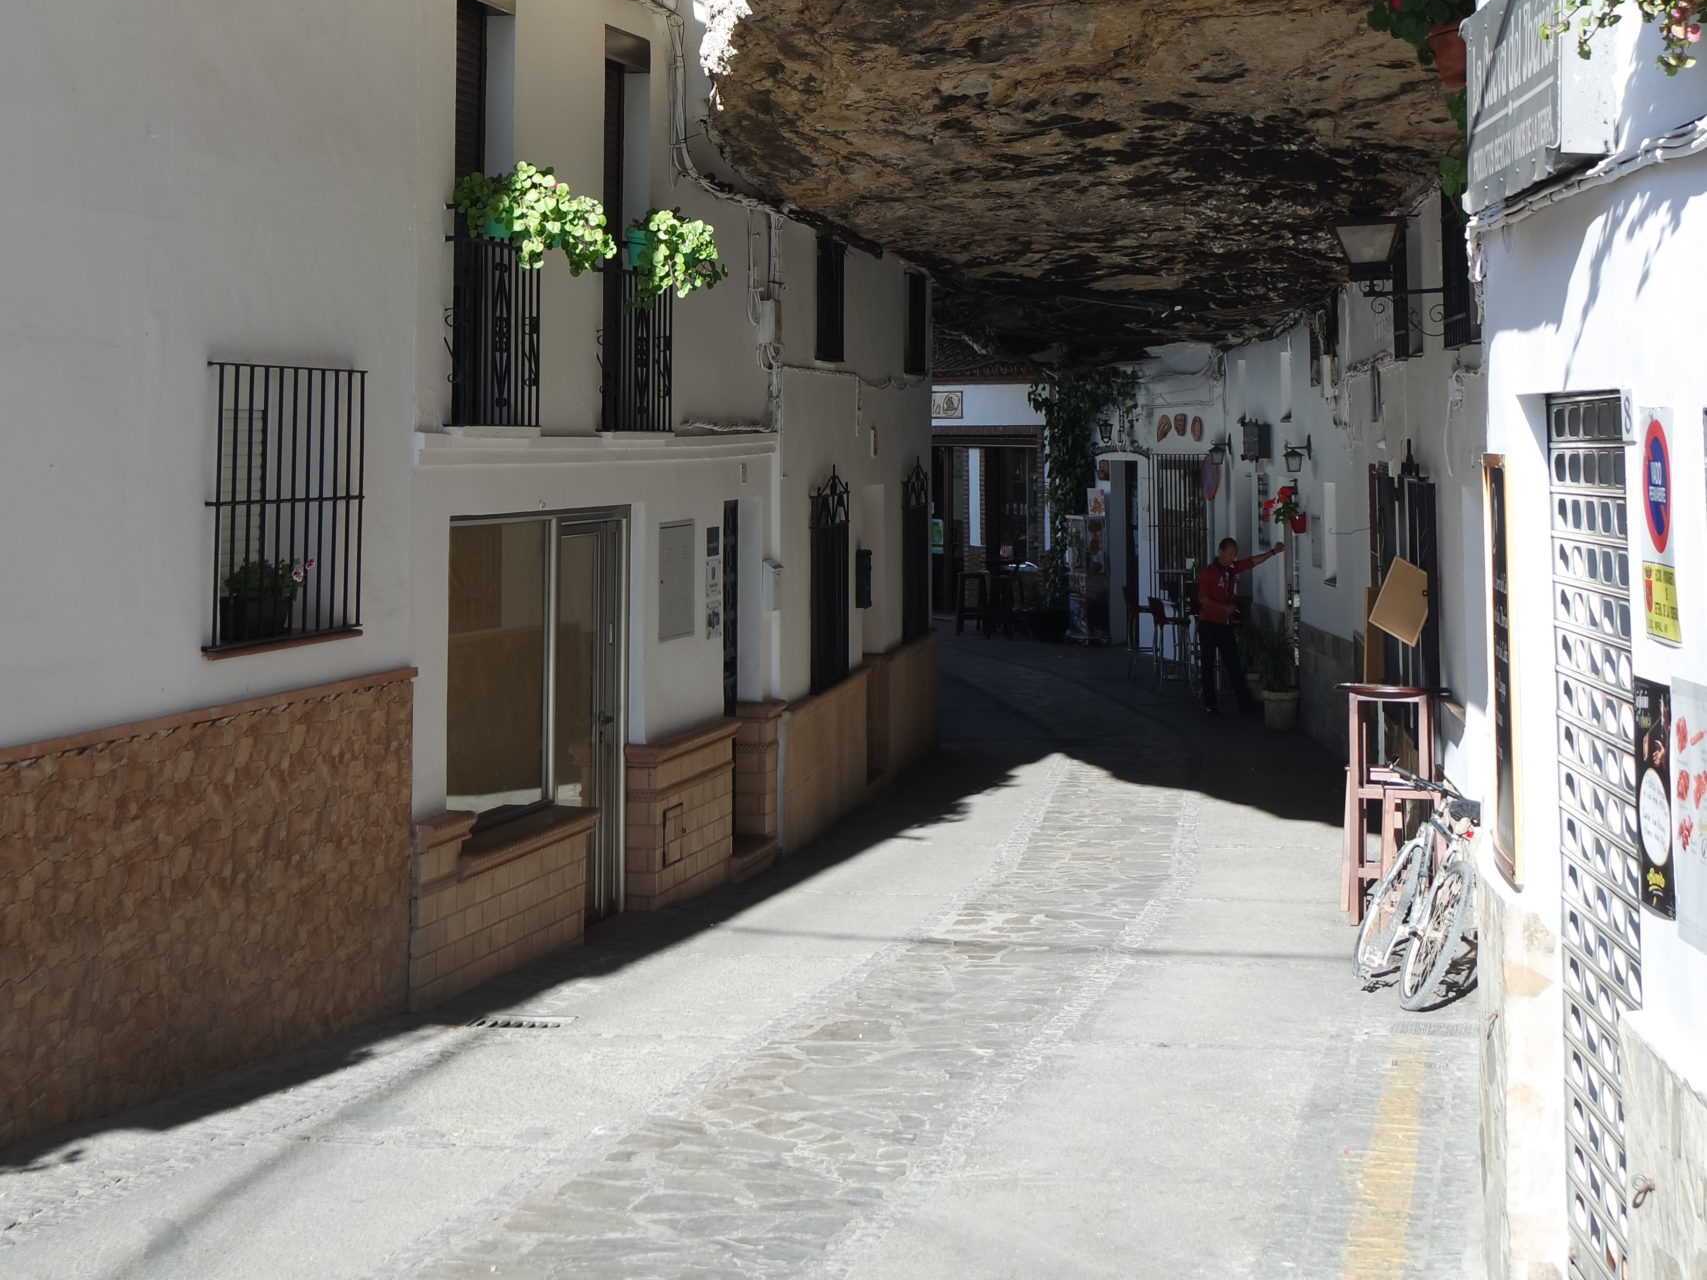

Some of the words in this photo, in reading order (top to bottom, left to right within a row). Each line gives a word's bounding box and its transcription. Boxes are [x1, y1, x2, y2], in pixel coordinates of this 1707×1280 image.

[1472, 47, 1482, 117] La
[1483, 36, 1506, 108] Cueva
[1508, 8, 1521, 91] del
[1624, 396, 1632, 435] 8
[1650, 462, 1662, 485] VADO
